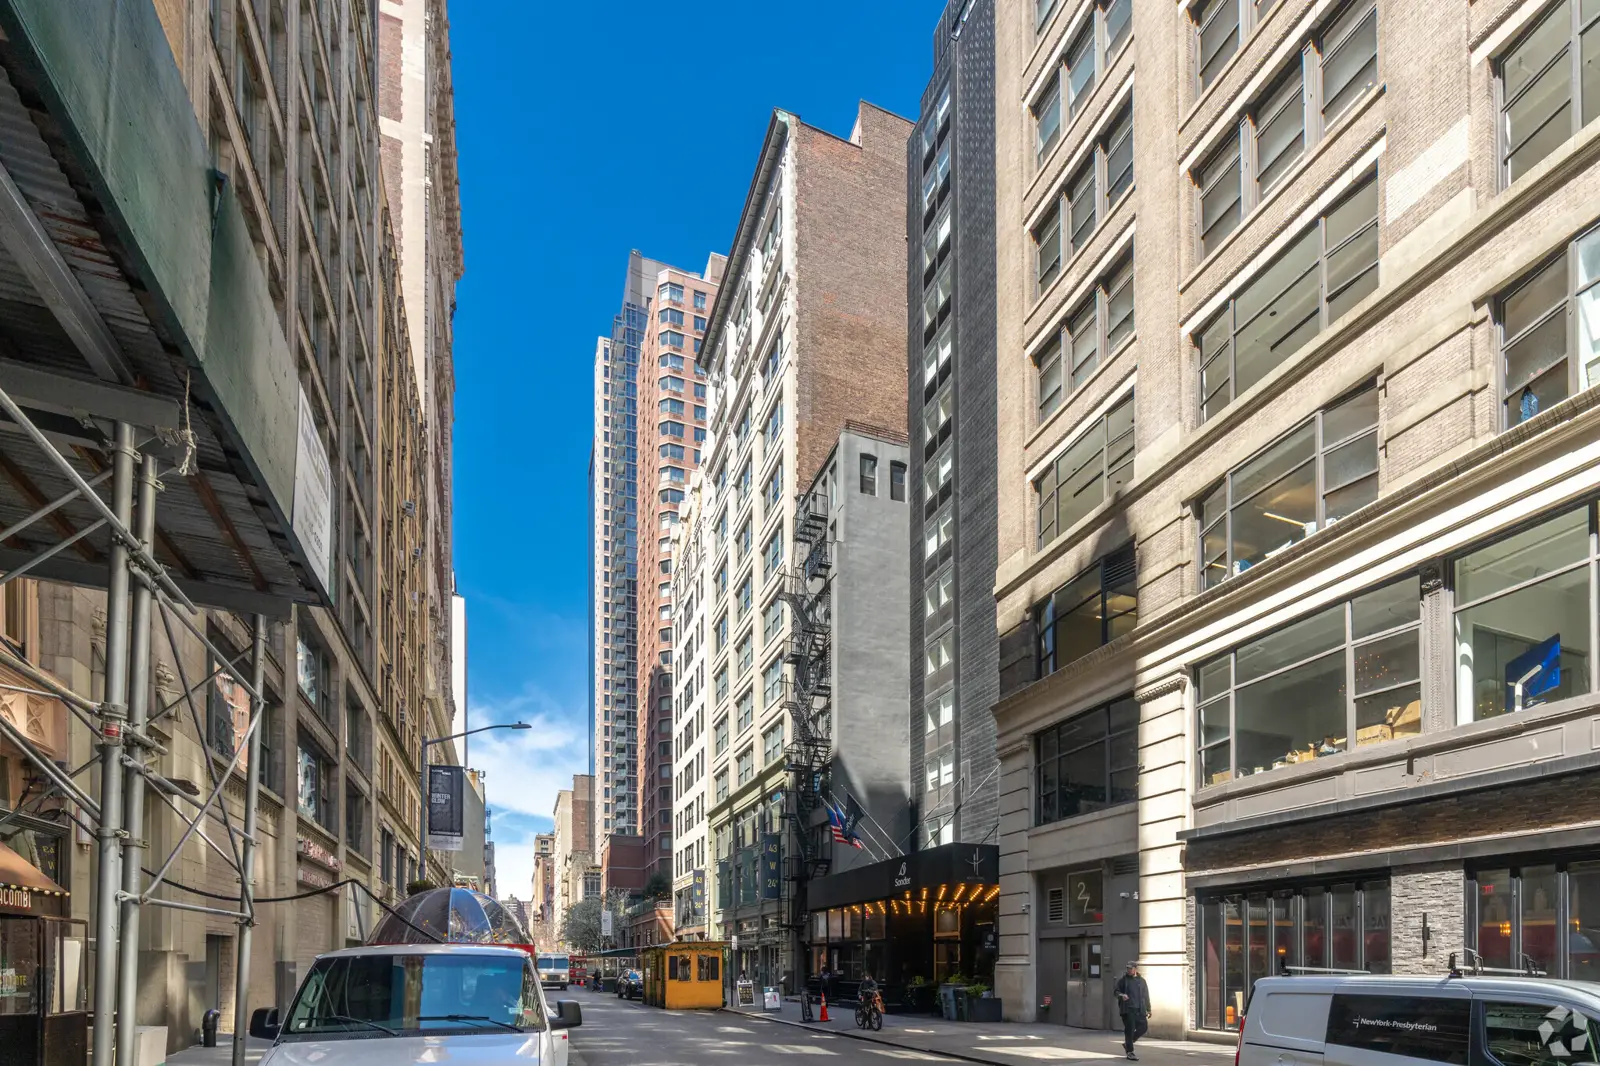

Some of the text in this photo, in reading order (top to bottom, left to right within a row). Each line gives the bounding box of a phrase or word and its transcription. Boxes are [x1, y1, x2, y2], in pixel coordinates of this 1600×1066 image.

[431, 792, 451, 800] WINTER
[768, 844, 778, 853] 43
[769, 861, 777, 870] W
[894, 877, 911, 887] Sonder
[1360, 1017, 1437, 1032] NewYork-Presbyterian
